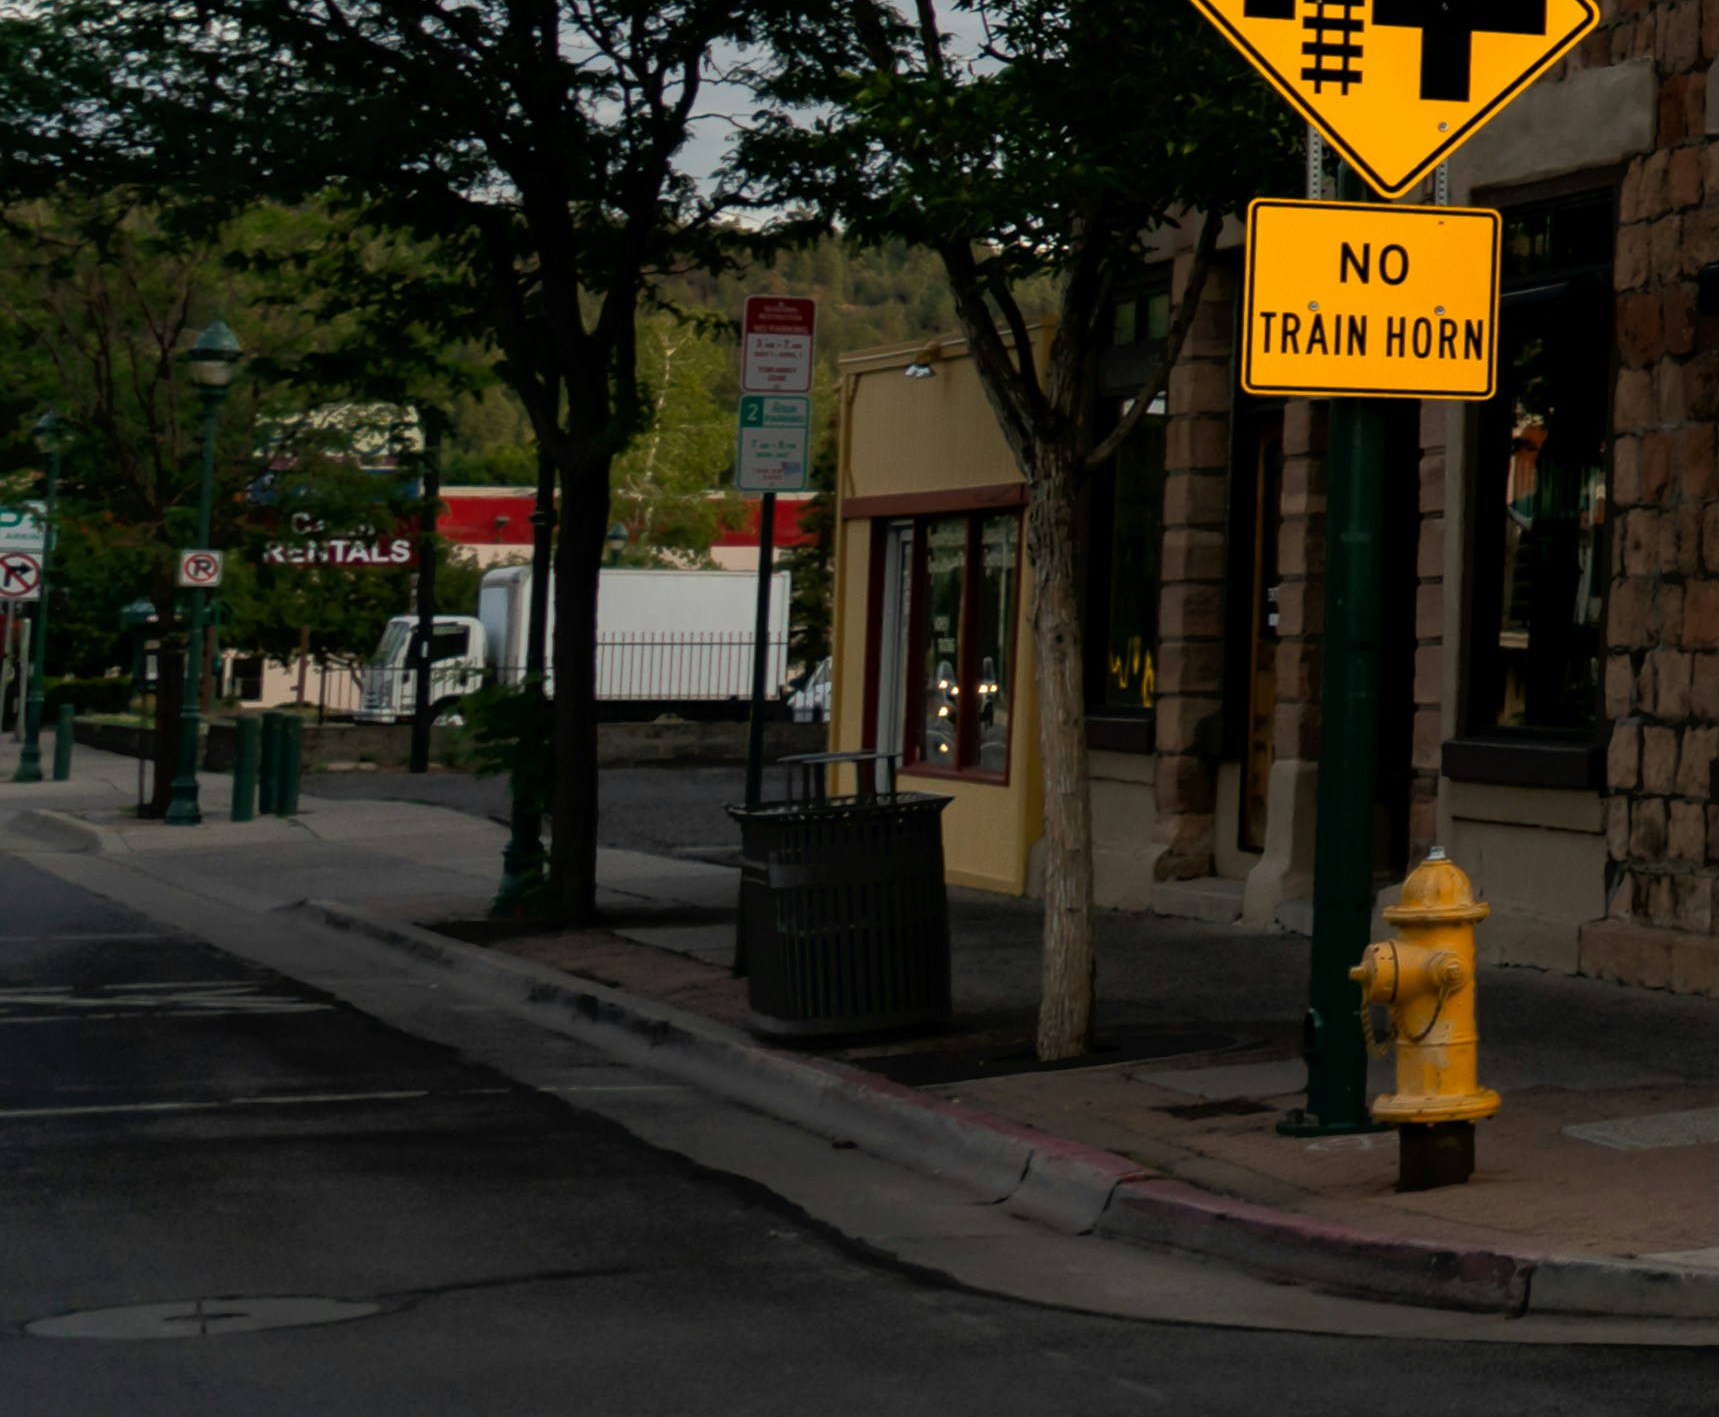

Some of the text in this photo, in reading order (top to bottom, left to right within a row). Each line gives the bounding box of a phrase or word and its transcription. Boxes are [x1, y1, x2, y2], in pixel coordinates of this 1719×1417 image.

[1341, 241, 1408, 285] NO
[1260, 312, 1485, 362] TRAIN HORN
[748, 403, 759, 421] 2
[262, 539, 412, 564] RENTALS
